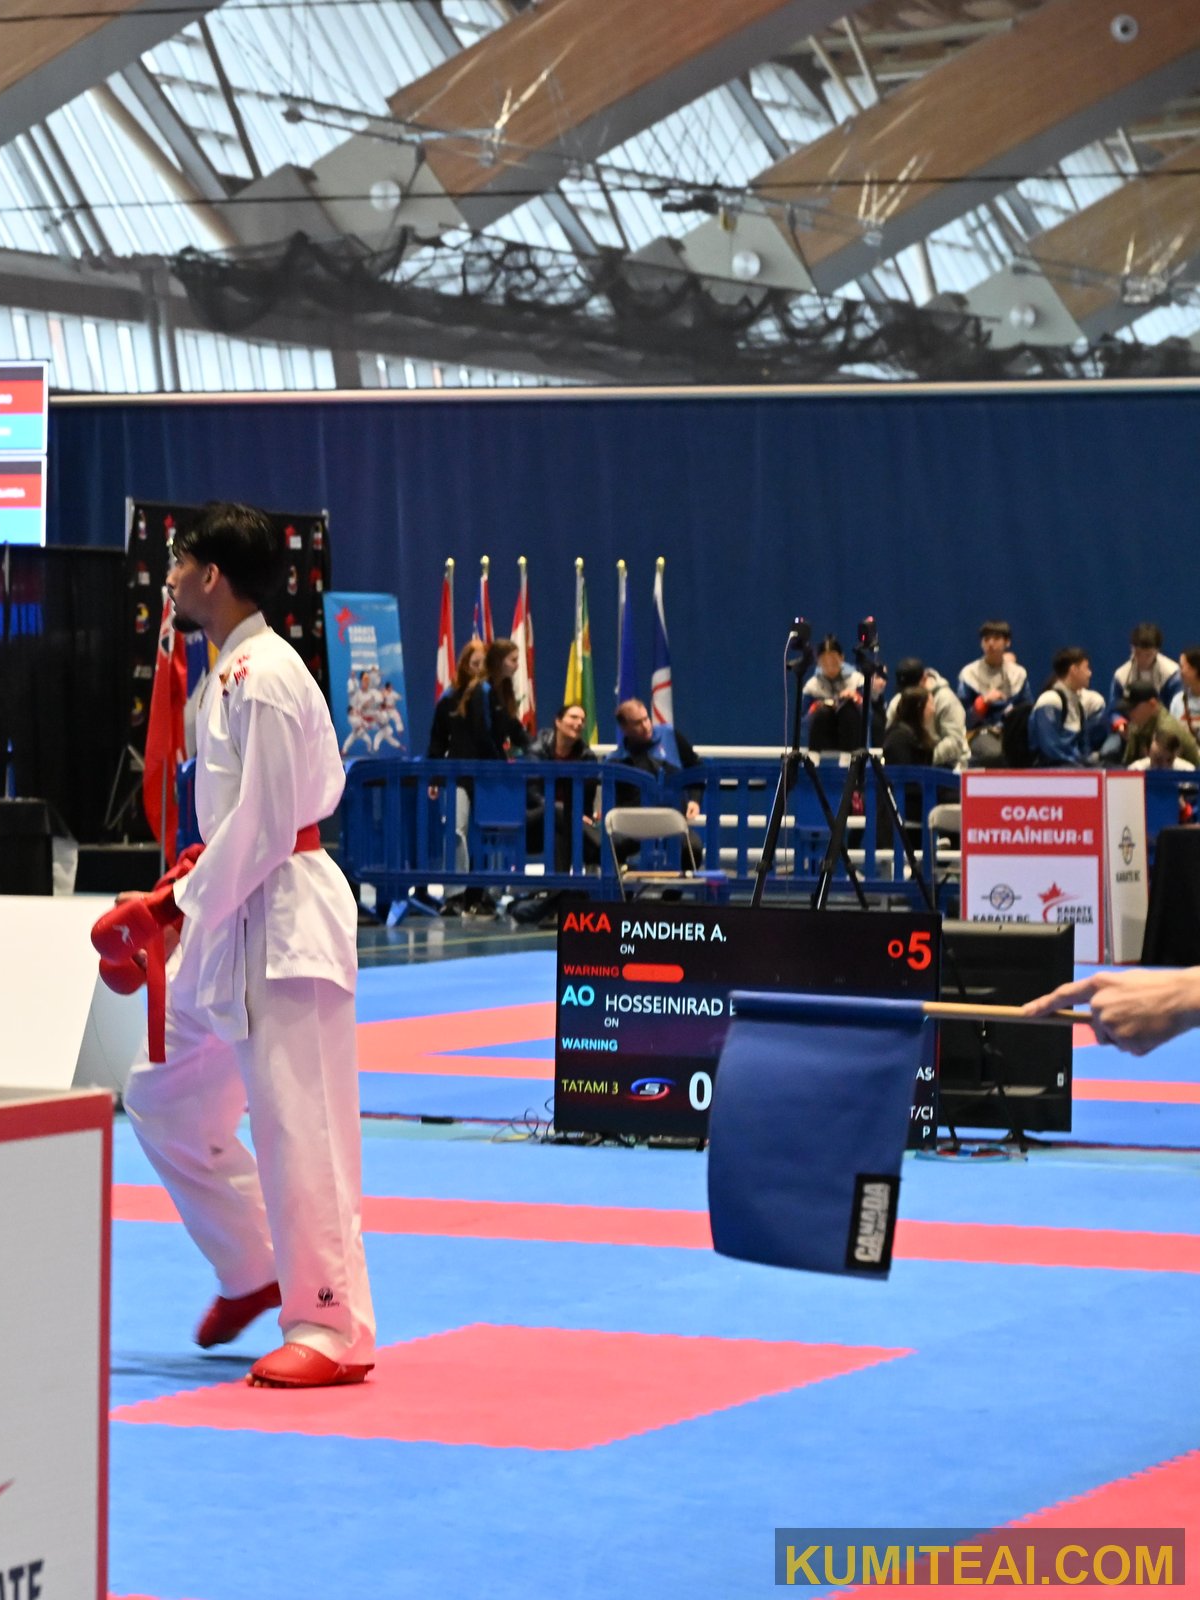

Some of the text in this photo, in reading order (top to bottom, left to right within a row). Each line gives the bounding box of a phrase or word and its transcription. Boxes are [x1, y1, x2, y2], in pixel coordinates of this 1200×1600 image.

[1001, 806, 1063, 821] COACH
[1057, 906, 1092, 914] KARATE
[973, 914, 1013, 922] KARATE
[1057, 914, 1094, 924] CANADA
[563, 912, 611, 933] AKA
[620, 920, 705, 942] PANDHER
[710, 924, 727, 942] A.
[620, 944, 635, 954] ON
[563, 965, 619, 977] WARNING
[561, 985, 595, 1006] AO
[605, 994, 724, 1016] HOSSEINIRAD
[604, 1017, 619, 1027] ON
[561, 1037, 618, 1052] WARNING
[561, 1079, 608, 1095] TATAMI
[612, 1082, 619, 1095] 3
[689, 1071, 712, 1111] 0
[854, 1183, 885, 1262] CANADA
